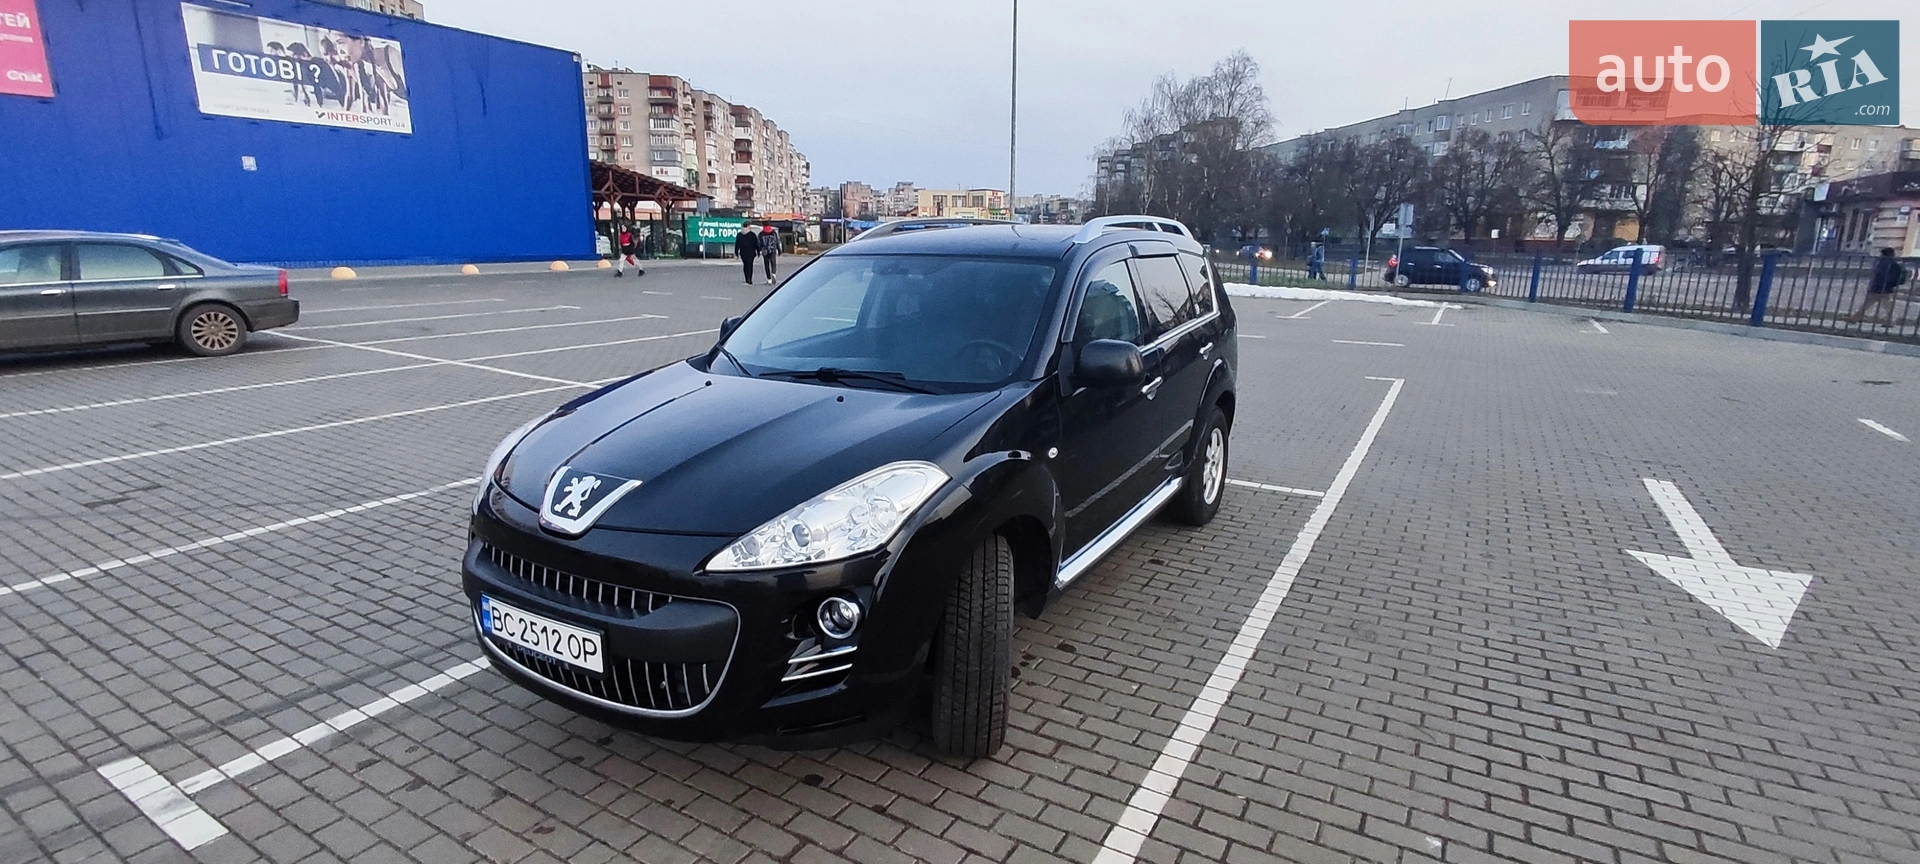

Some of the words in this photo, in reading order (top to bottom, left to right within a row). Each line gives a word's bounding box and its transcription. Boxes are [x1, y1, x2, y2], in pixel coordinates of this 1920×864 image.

[212, 49, 302, 80] ГОТОВІ
[308, 64, 321, 83] ?
[699, 228, 717, 238] САД.
[491, 606, 516, 637] BC
[518, 617, 564, 656] 2512
[567, 633, 598, 663] OP
